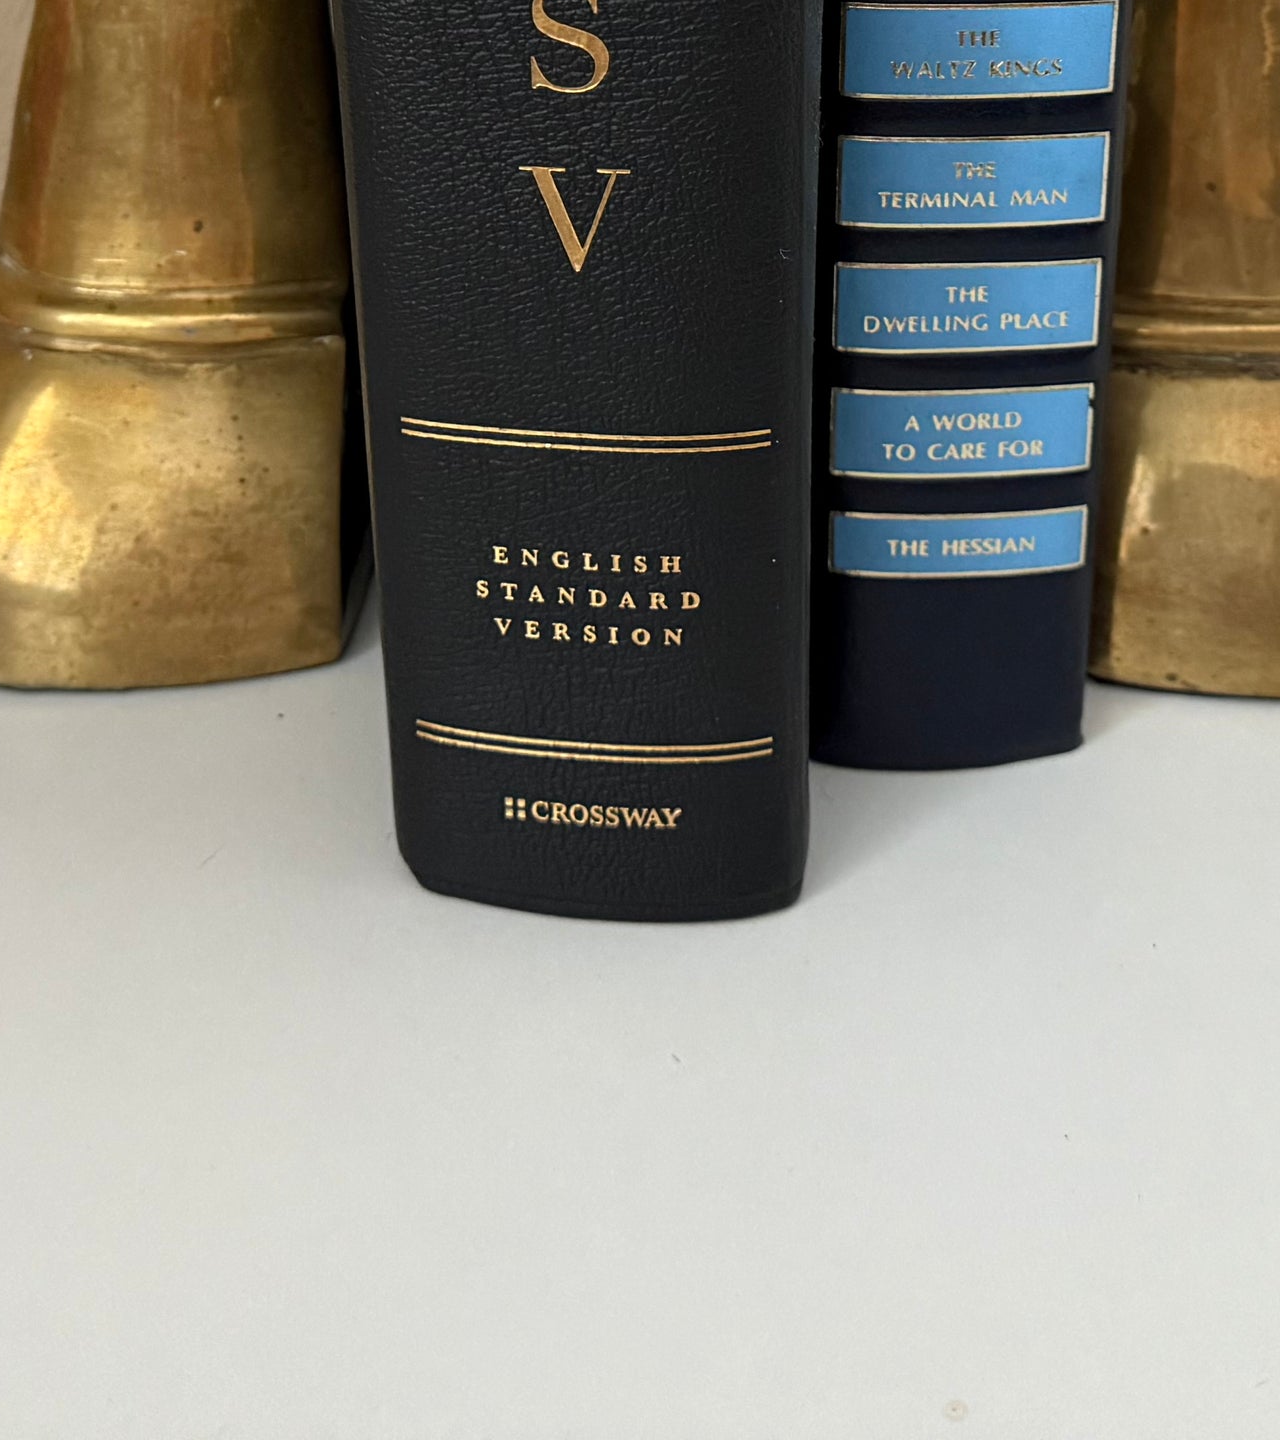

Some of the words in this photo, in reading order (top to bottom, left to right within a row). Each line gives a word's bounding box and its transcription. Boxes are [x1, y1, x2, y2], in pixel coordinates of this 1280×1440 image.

[956, 29, 1001, 48] THE
[890, 60, 977, 80] WALTZ
[988, 58, 1063, 79] KINGS
[953, 161, 997, 180] THE
[878, 190, 999, 209] TERMINAL
[1010, 188, 1068, 207] MAN
[945, 285, 989, 304] THE
[863, 313, 989, 334] DWELLING
[999, 310, 1069, 331] PLACE
[904, 415, 921, 433] A
[932, 411, 1023, 432] WORLD
[882, 443, 917, 462] TO
[926, 441, 987, 460] CARE
[997, 439, 1044, 458] FOR
[887, 538, 930, 558] THE
[941, 535, 1036, 557] HESSIAN
[491, 544, 682, 574] ENGLISH
[475, 579, 701, 610] STANDARD
[493, 617, 683, 646] VERSION
[530, 800, 682, 829] CROSSWAY
